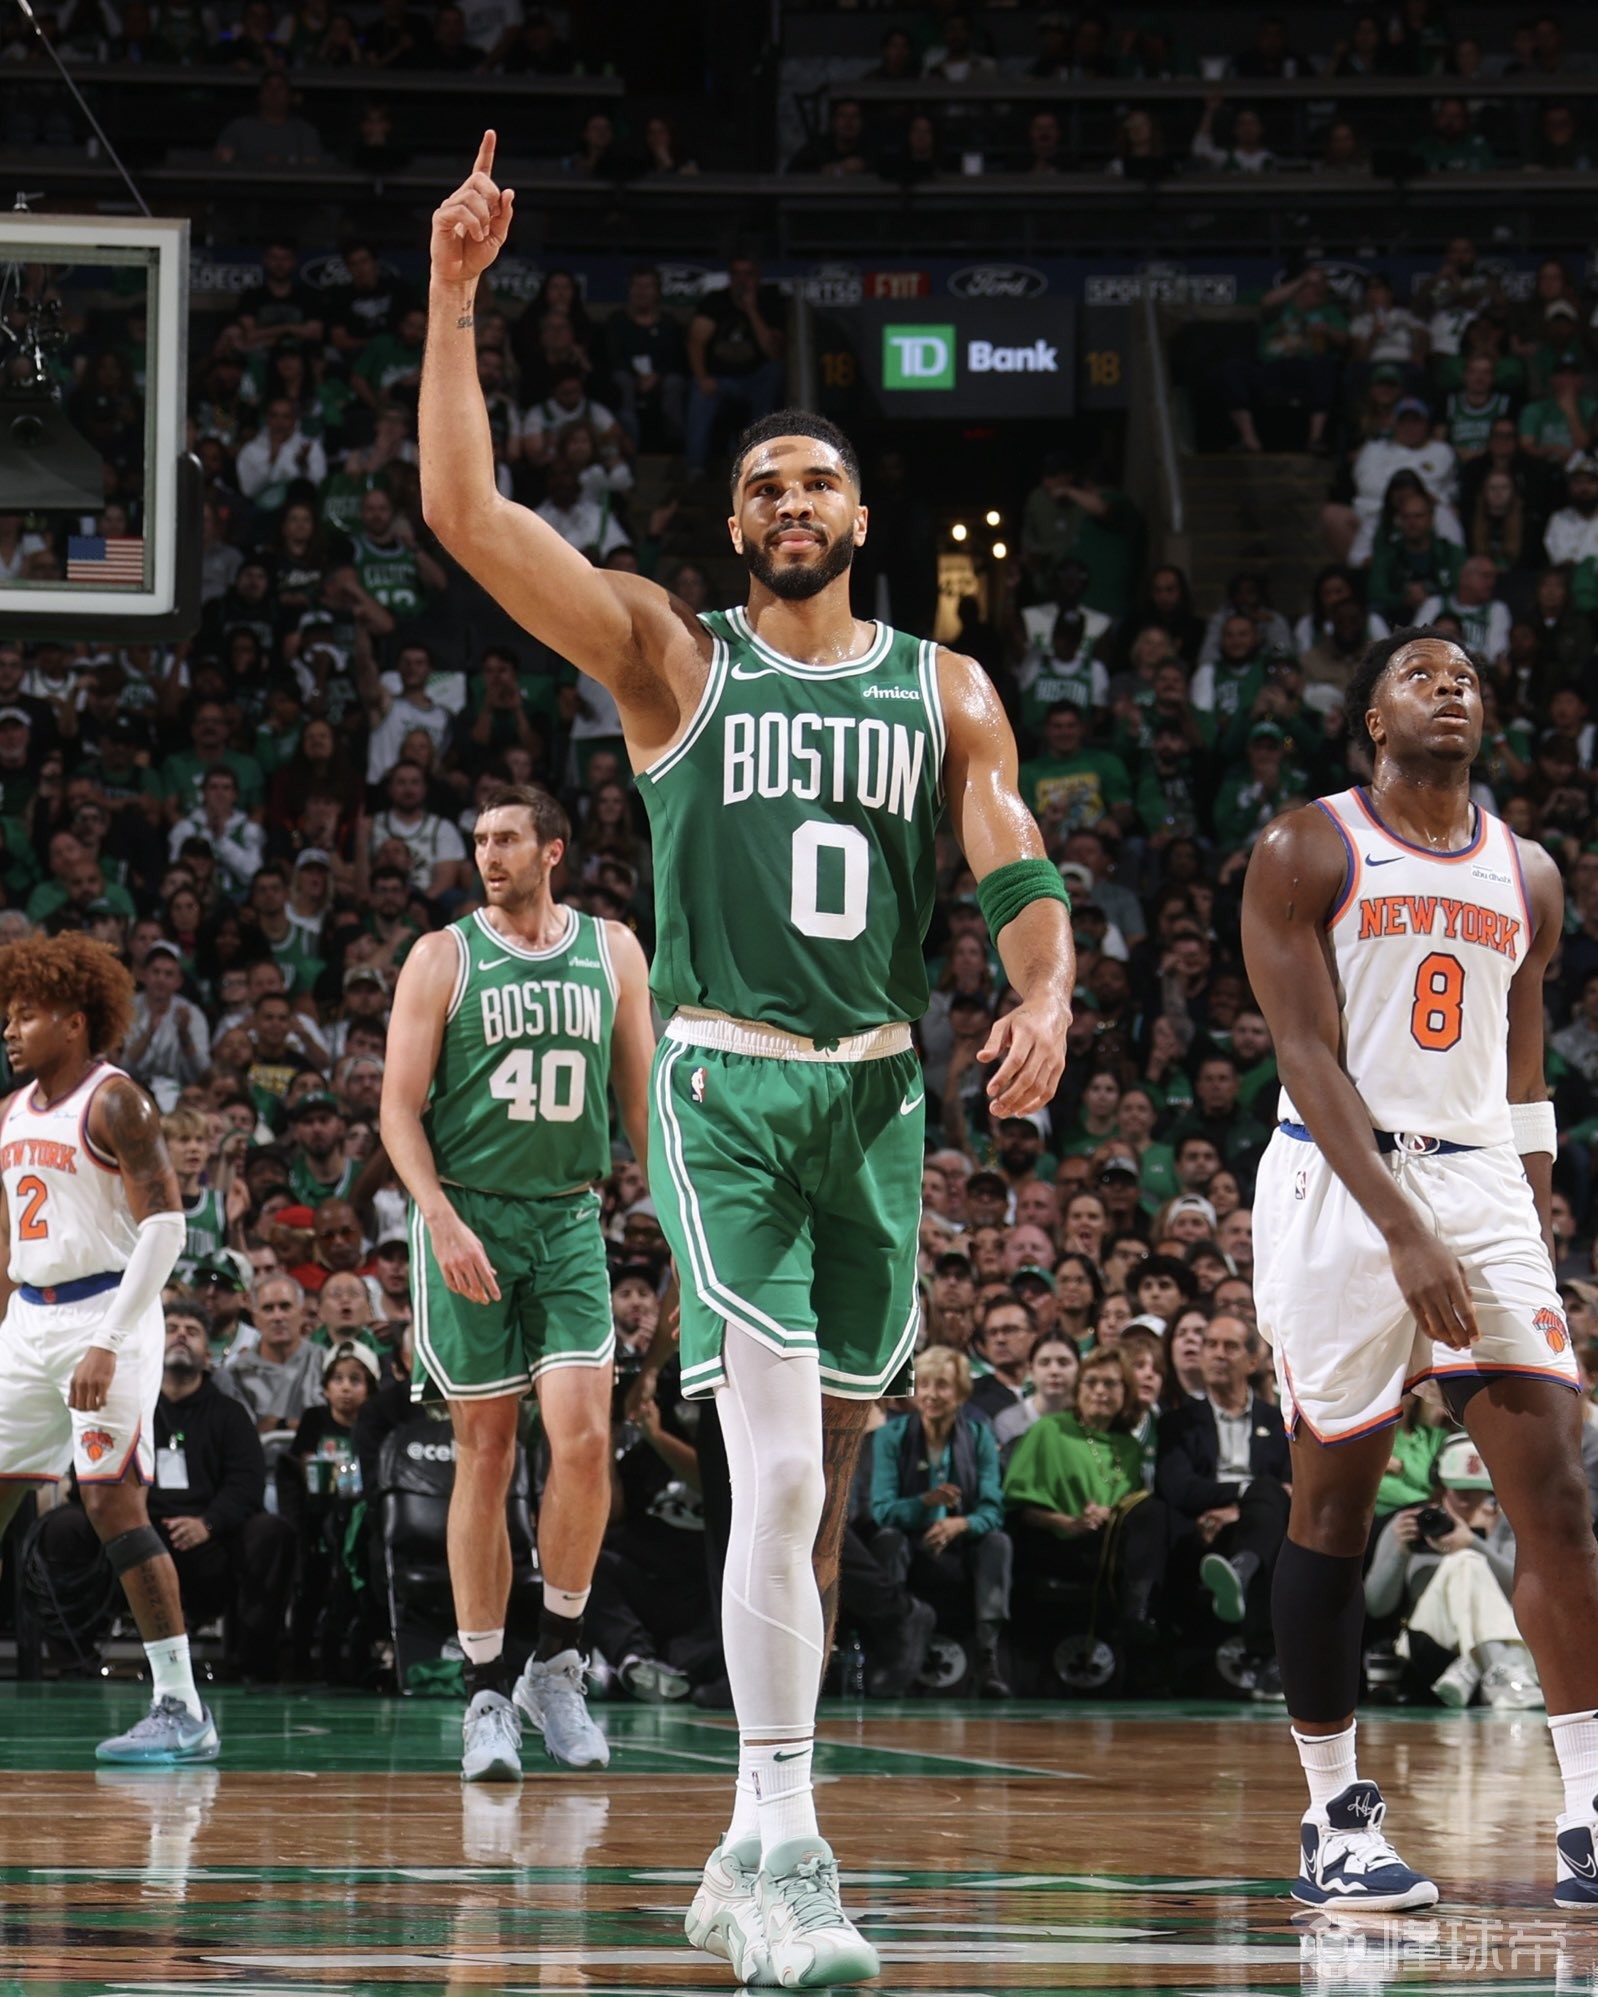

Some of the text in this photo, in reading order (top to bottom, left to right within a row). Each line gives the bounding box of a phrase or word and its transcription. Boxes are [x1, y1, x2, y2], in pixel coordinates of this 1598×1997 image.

[966, 265, 1026, 297] Ford
[820, 352, 856, 387] 18
[889, 336, 1058, 377] TD Bank
[1085, 351, 1121, 386] 18
[863, 685, 920, 700] Amica
[723, 712, 925, 822] BOSTON
[791, 820, 869, 940] 0
[1359, 895, 1520, 961] NEW YORK
[480, 980, 601, 1046] BOSTON
[1410, 951, 1465, 1052] 8
[489, 1049, 586, 1122] 40
[27, 1139, 77, 1175] YORK
[17, 1174, 48, 1241] 2
